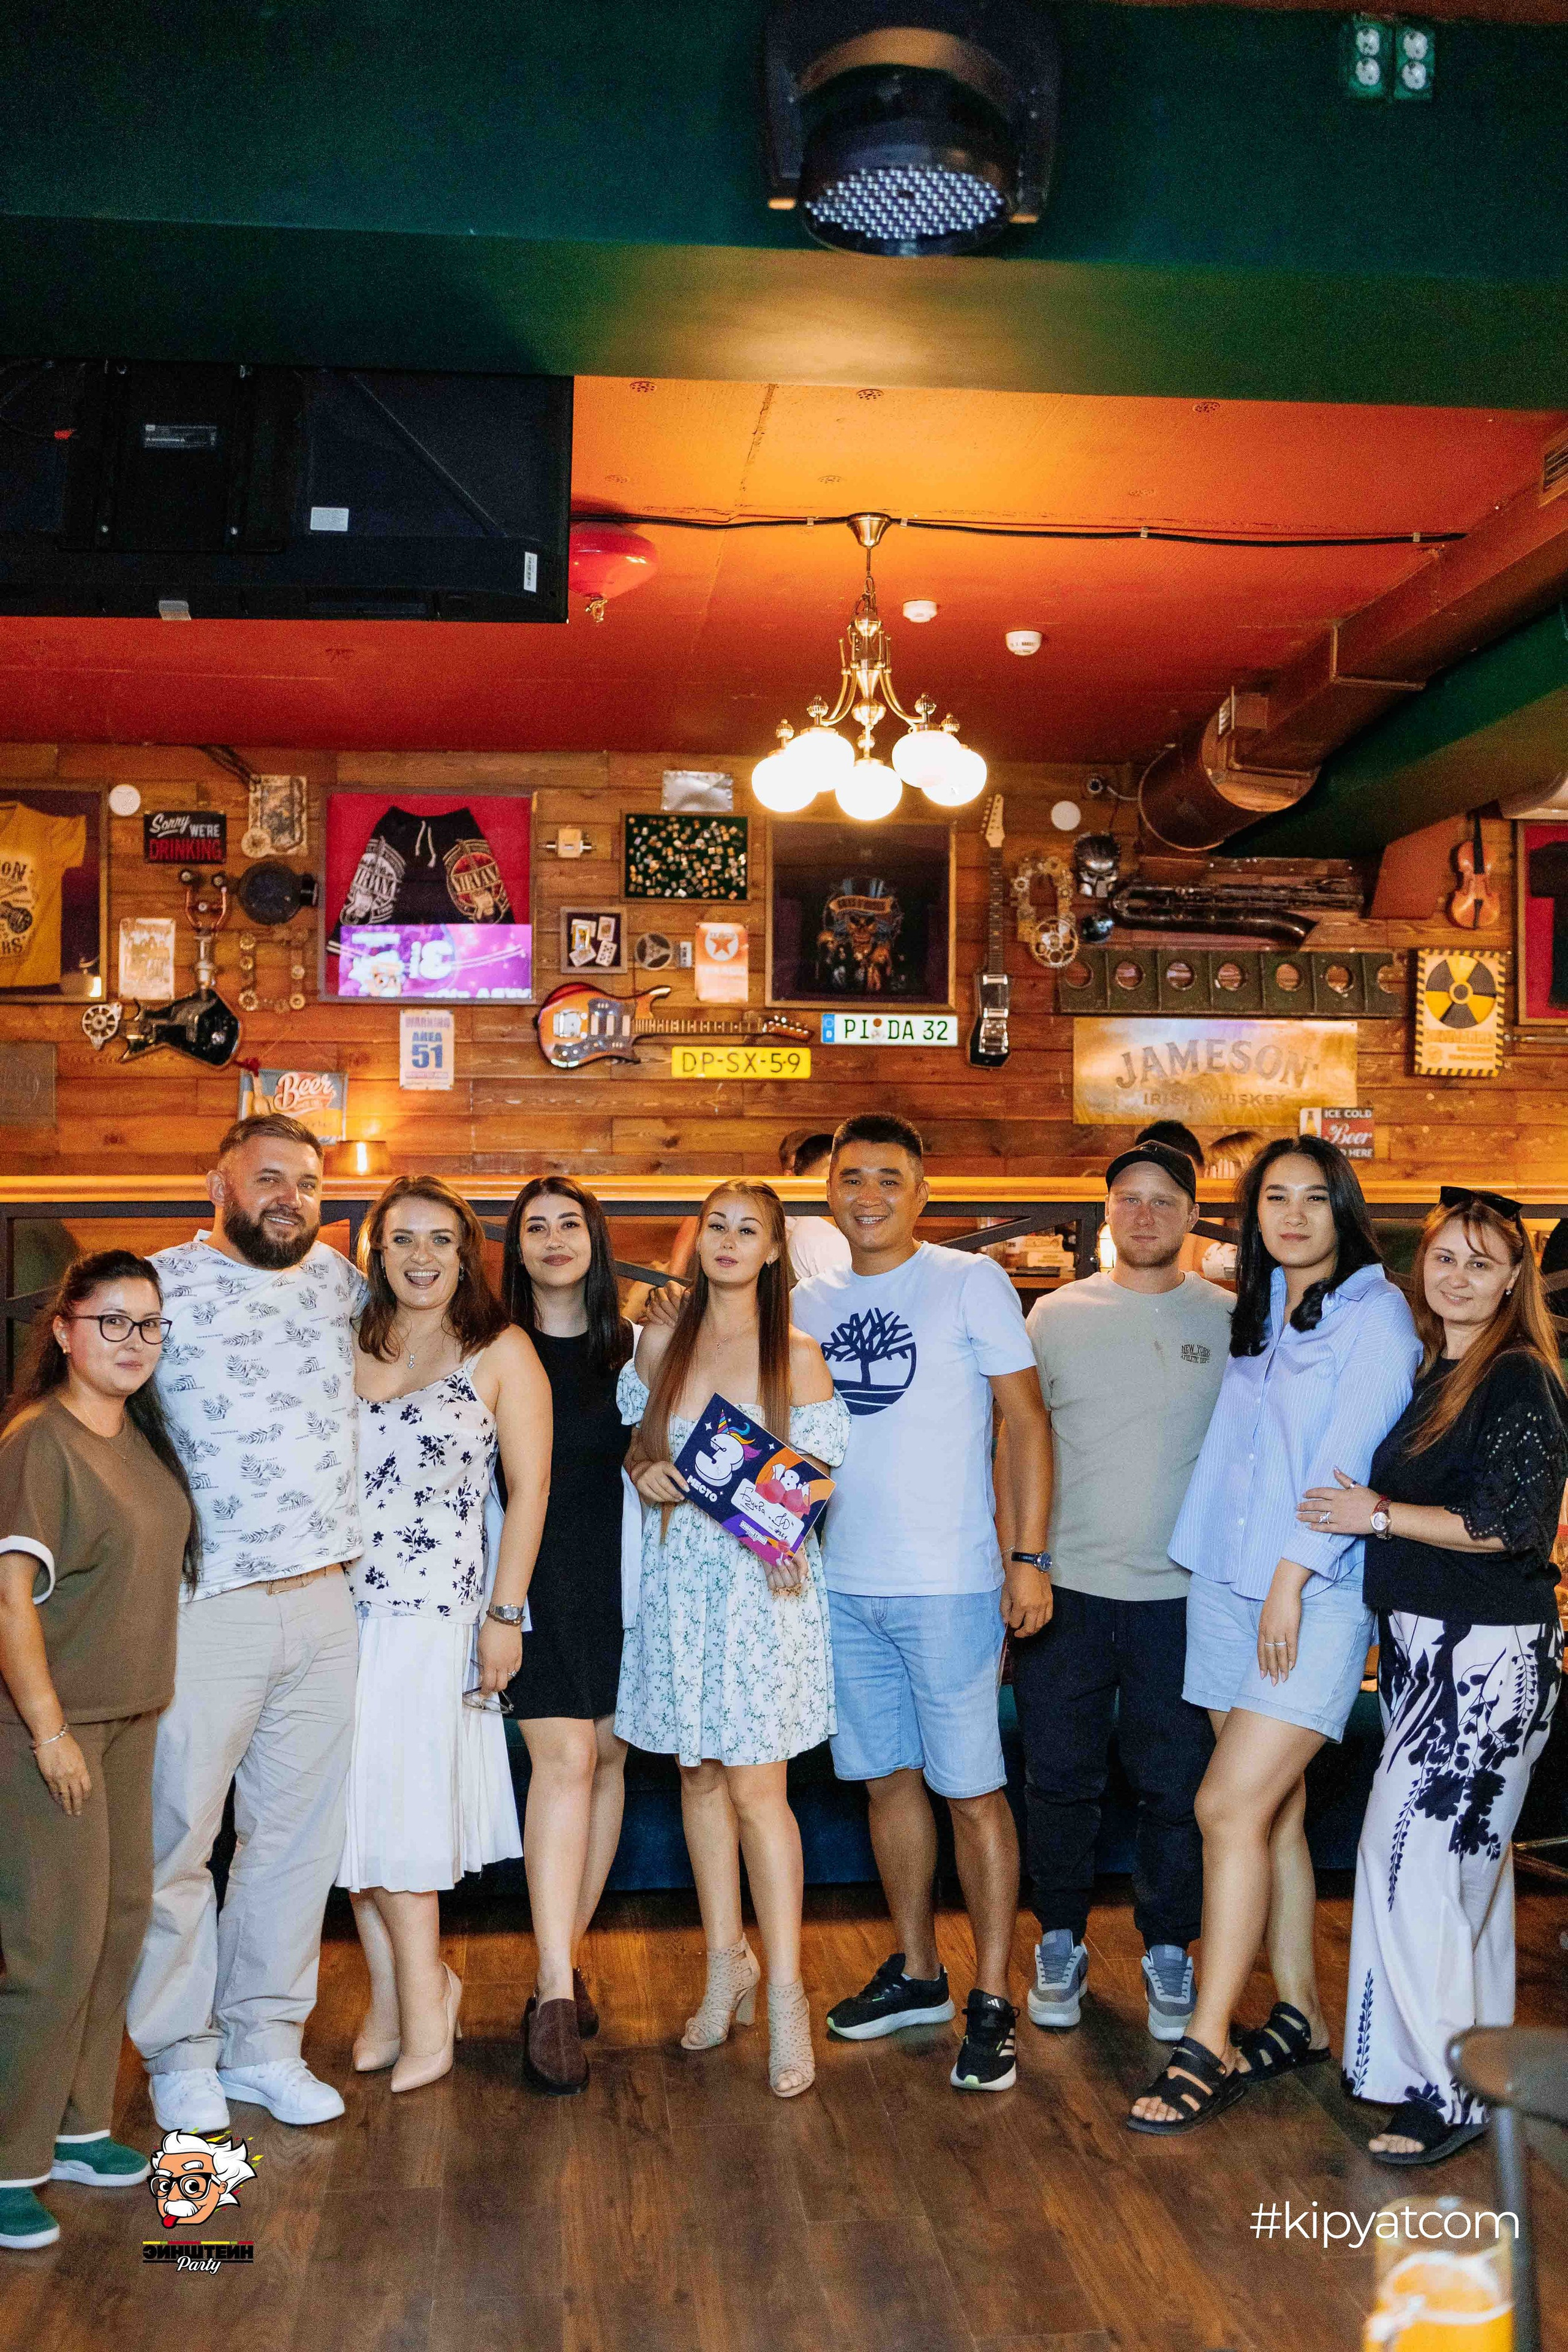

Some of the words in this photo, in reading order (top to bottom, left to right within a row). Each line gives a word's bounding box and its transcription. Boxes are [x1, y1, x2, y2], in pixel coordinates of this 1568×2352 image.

[149, 813, 190, 838] Sorry
[149, 839, 222, 859] DRINKING
[451, 862, 502, 893] NIRVAN
[412, 1031, 442, 1041] AREA
[923, 1020, 948, 1040] 32
[412, 1044, 442, 1068] 51
[683, 1052, 800, 1073] DP-SX-59
[1115, 1039, 1313, 1089] JAMESON
[273, 1072, 336, 1111] Beer
[1202, 1093, 1286, 1105] WHISKEY
[1324, 1109, 1341, 1118] ICE
[1344, 1109, 1373, 1118] COLD
[1325, 1123, 1373, 1145] Beer
[1349, 1148, 1373, 1158] HERE
[1182, 1344, 1194, 1353] NEW
[1196, 1344, 1211, 1355] YORK
[695, 1433, 744, 1487] 3
[687, 1475, 718, 1502] МЕСТО
[740, 1487, 766, 1515] Буква
